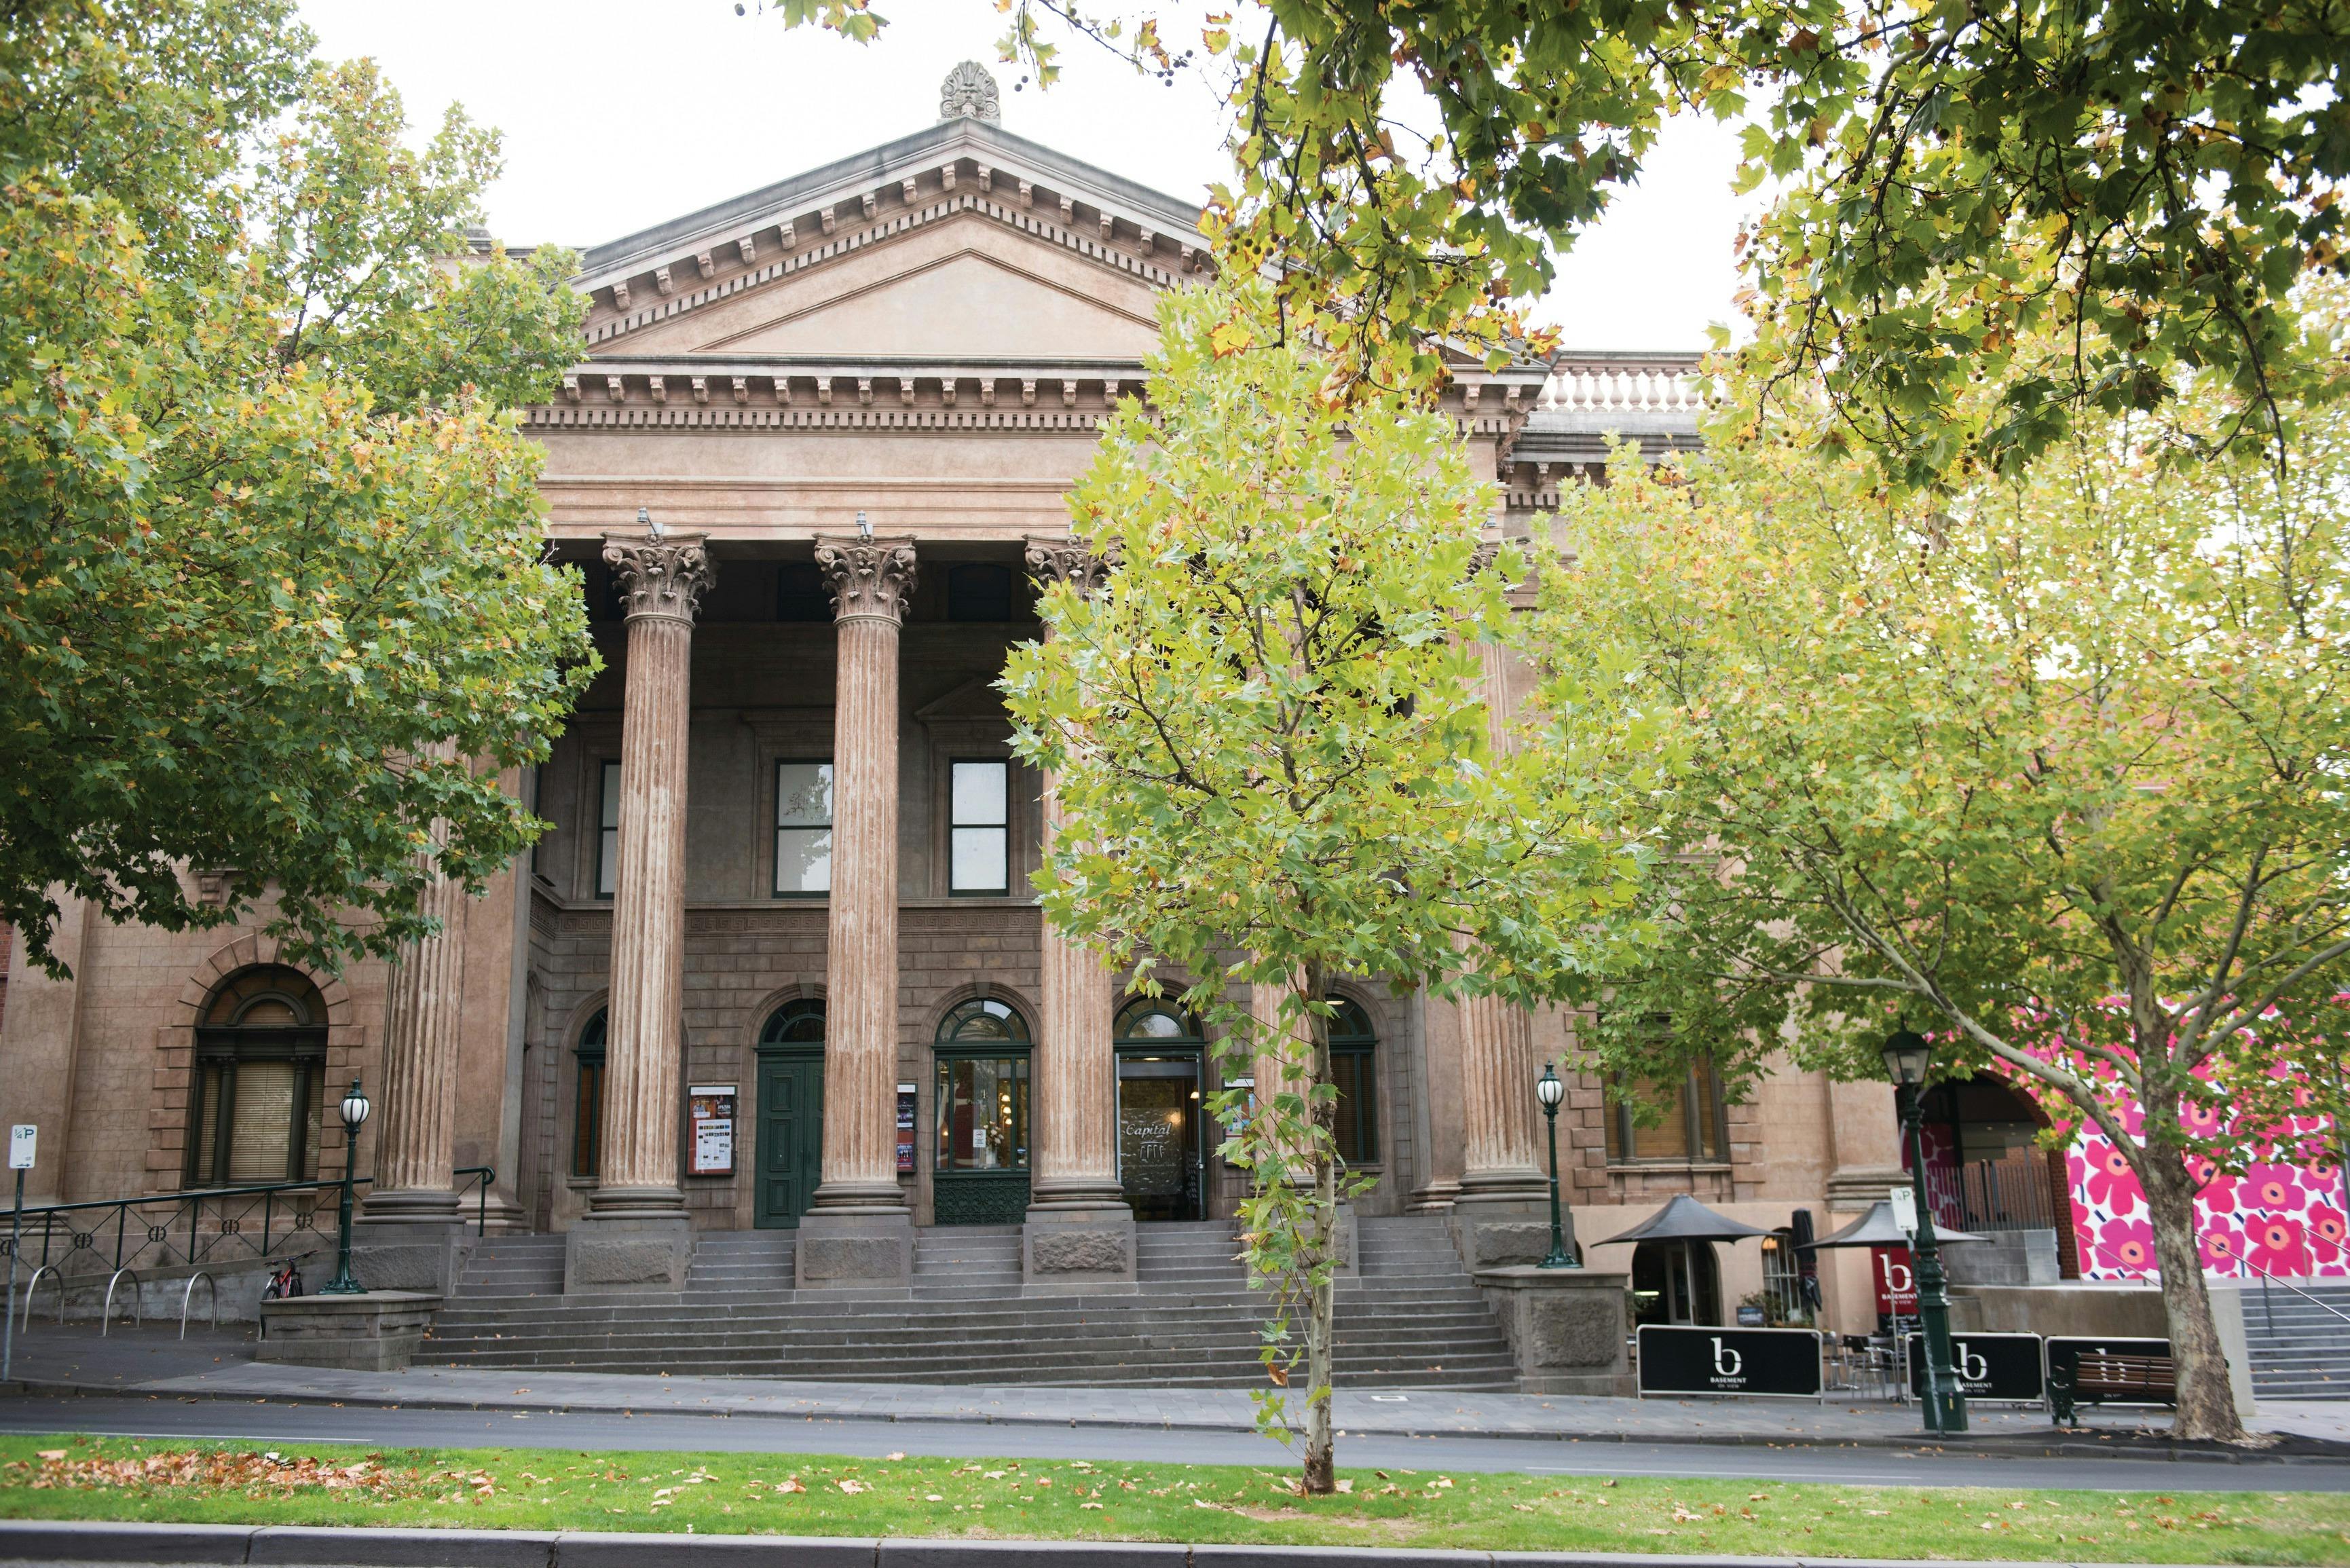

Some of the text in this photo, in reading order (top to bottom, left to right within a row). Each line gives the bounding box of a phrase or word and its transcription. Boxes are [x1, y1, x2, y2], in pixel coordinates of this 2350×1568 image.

[1126, 1122, 1172, 1138] Capital
[1710, 1337, 1742, 1376] b
[1956, 1343, 1988, 1380] b
